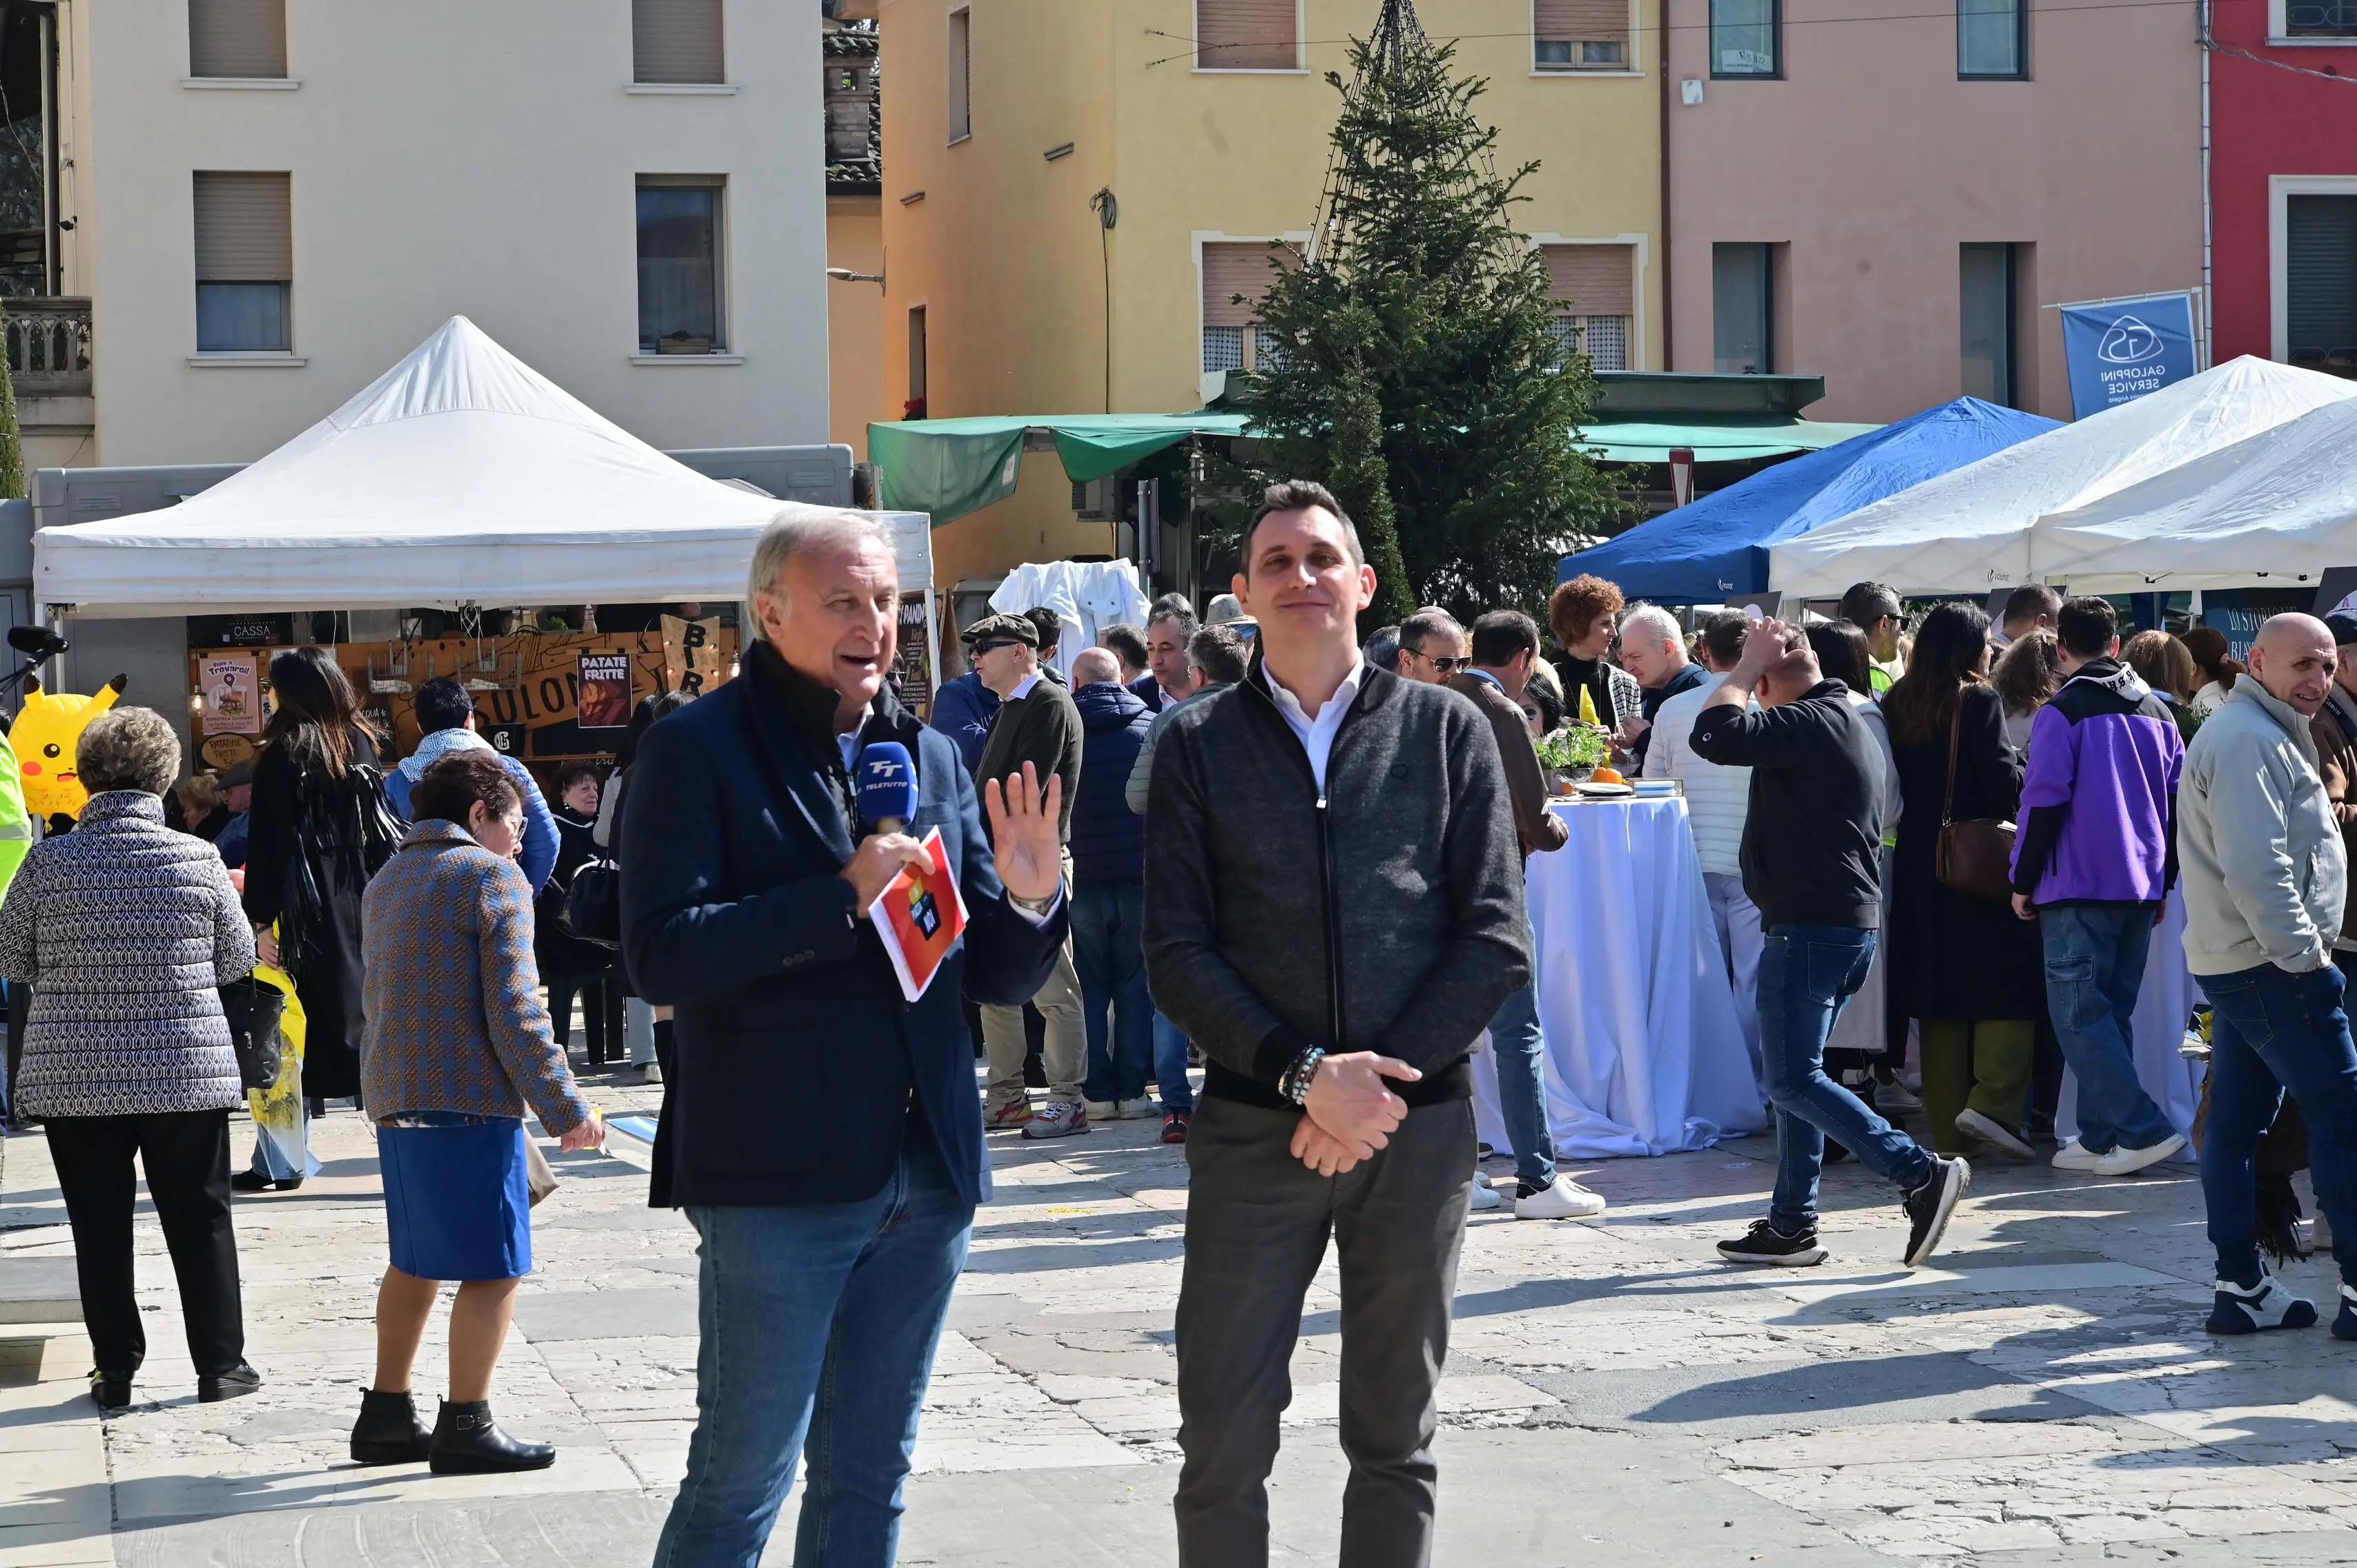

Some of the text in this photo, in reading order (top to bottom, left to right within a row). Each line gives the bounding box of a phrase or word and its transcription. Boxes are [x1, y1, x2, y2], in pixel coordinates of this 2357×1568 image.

[234, 625, 271, 637] CASSA
[581, 657, 627, 669] PATATE
[584, 668, 625, 680] FRITTE
[866, 782, 908, 791] TELETUTTO
